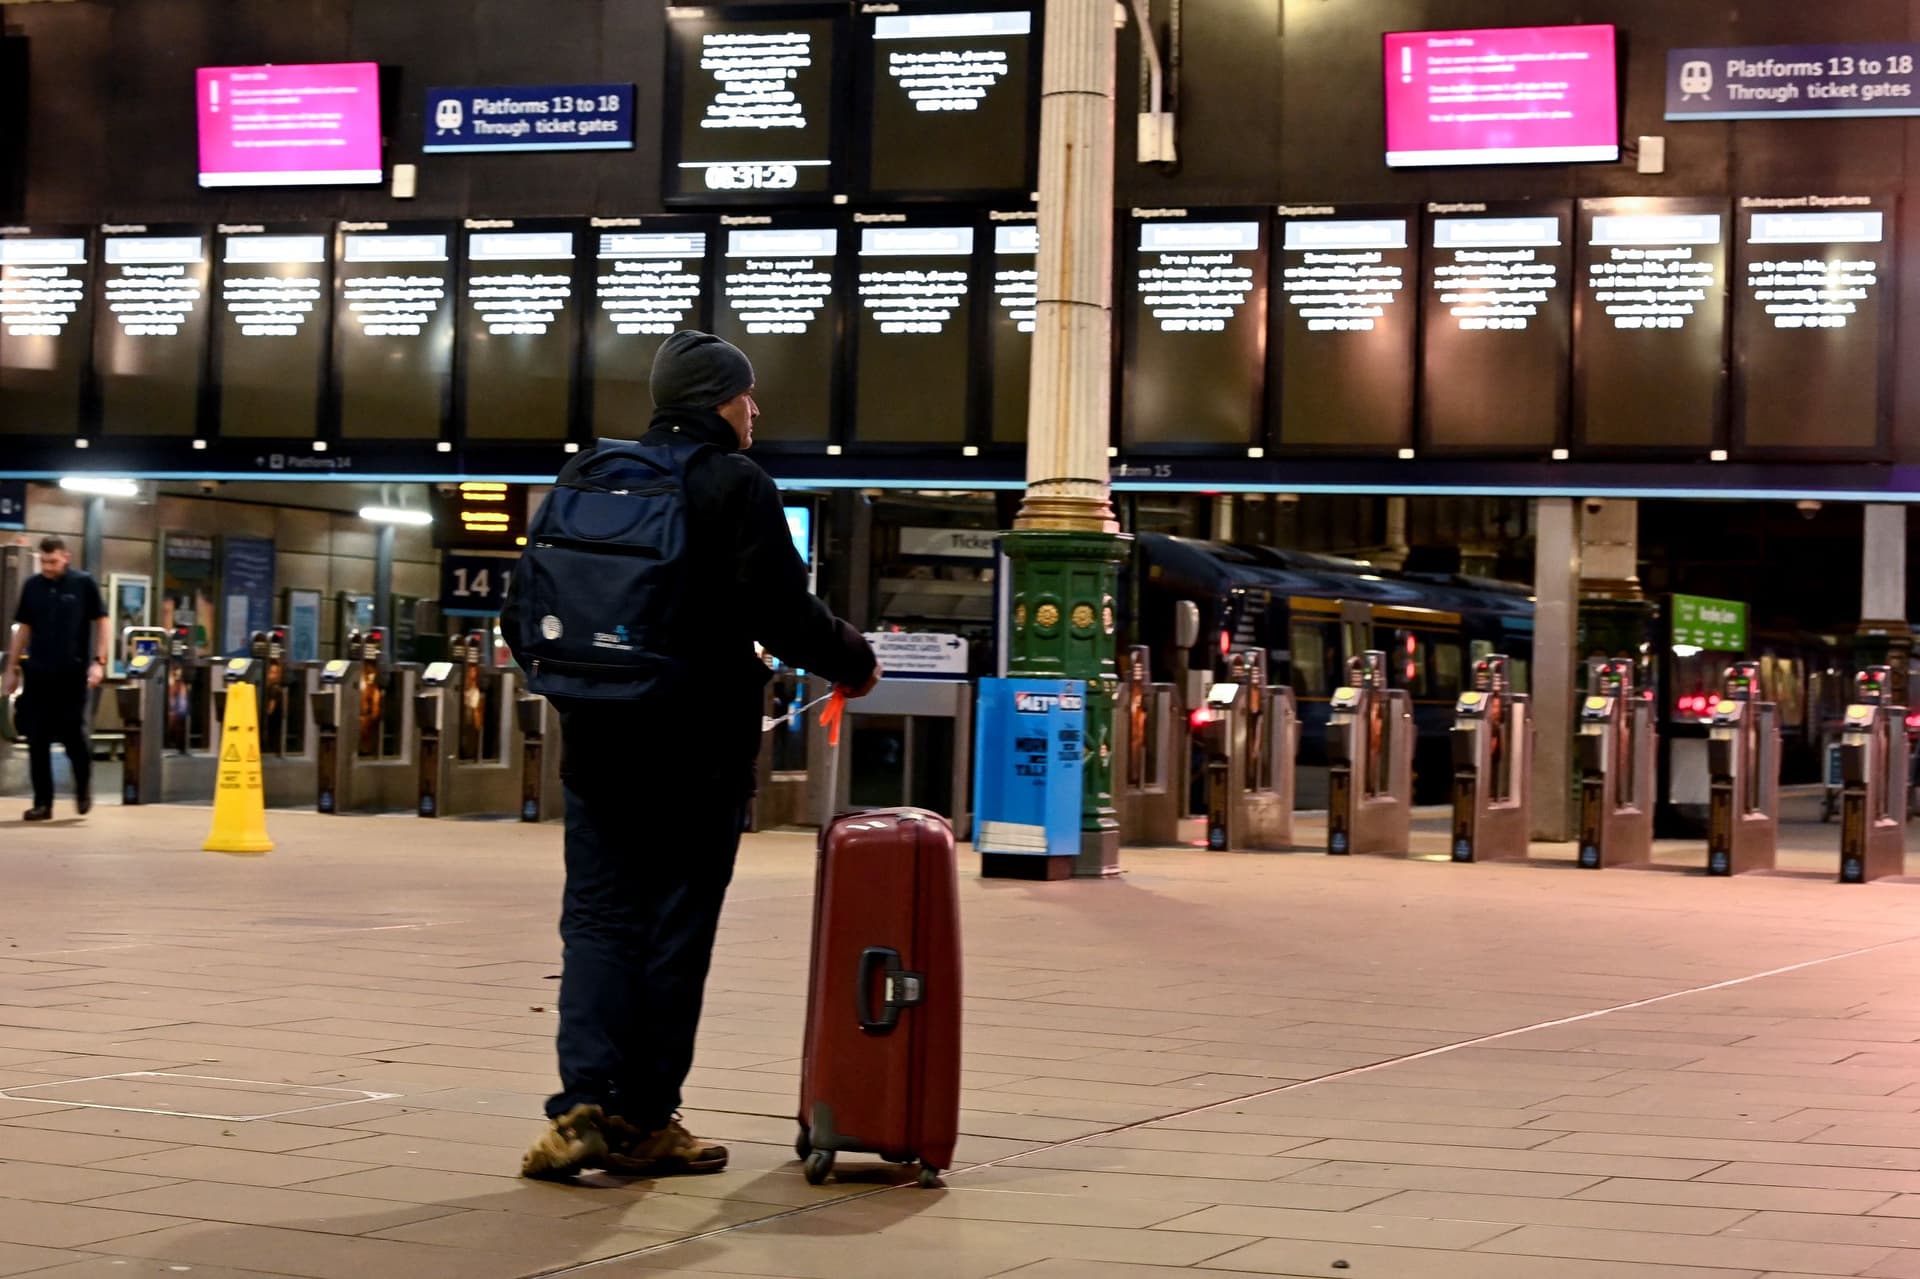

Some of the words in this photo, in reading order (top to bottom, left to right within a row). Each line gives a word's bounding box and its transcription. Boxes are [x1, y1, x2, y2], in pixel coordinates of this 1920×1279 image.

[1727, 59, 1823, 78] Platforms
[1828, 57, 1853, 76] 13
[1859, 59, 1881, 75] to
[1886, 55, 1913, 74] 18
[1727, 83, 1799, 102] Through
[1806, 82, 1858, 99] ticket
[1861, 82, 1911, 101] gates
[472, 98, 549, 115] Platforms
[552, 96, 573, 113] 13
[576, 98, 595, 113] to
[598, 95, 620, 112] 18
[473, 119, 530, 137] Through
[535, 119, 576, 133] ticket
[578, 120, 618, 135] gates
[1278, 205, 1335, 216] Departures
[1427, 202, 1486, 214] Departures
[1154, 465, 1172, 477] 15
[951, 534, 992, 550] Ticke
[453, 568, 491, 597] 14
[500, 570, 512, 598] 1
